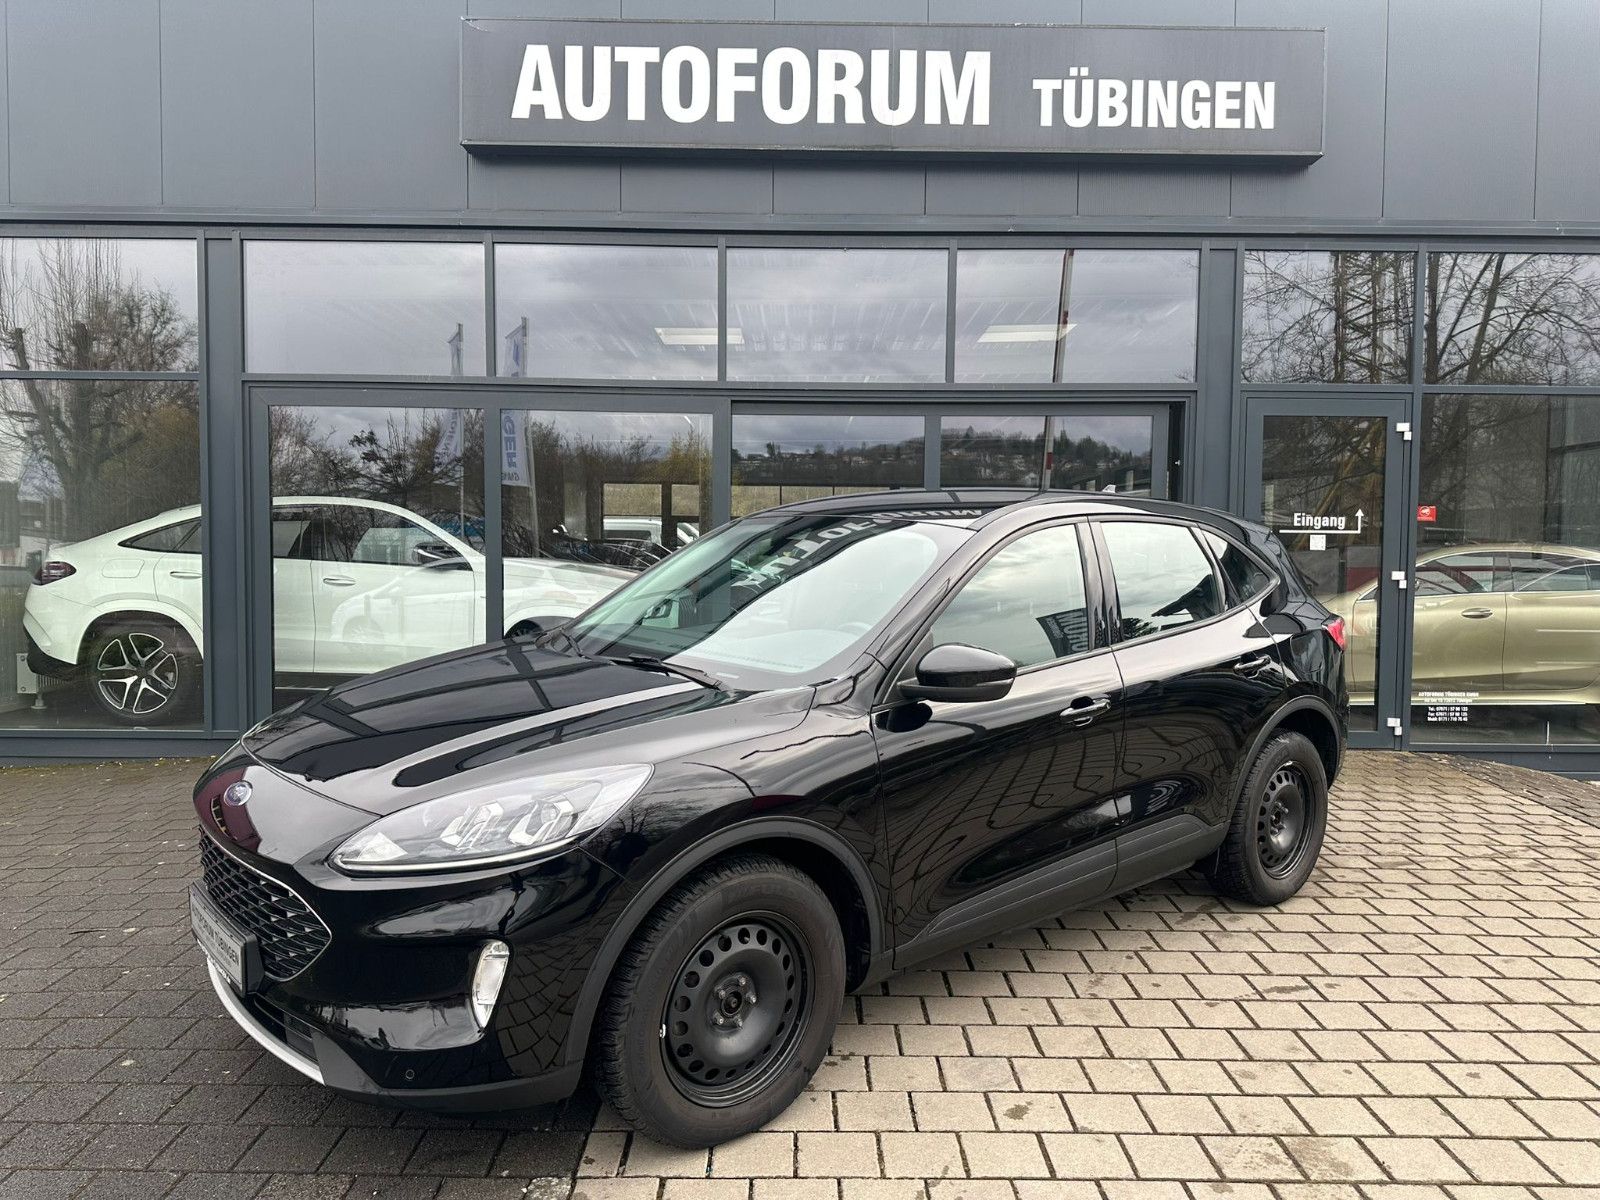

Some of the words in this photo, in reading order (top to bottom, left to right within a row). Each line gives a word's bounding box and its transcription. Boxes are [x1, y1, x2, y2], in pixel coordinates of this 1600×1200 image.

[512, 44, 991, 126] AUTOFORUM
[1033, 66, 1277, 131] TÜBINGEN
[1293, 512, 1346, 529] Eingang
